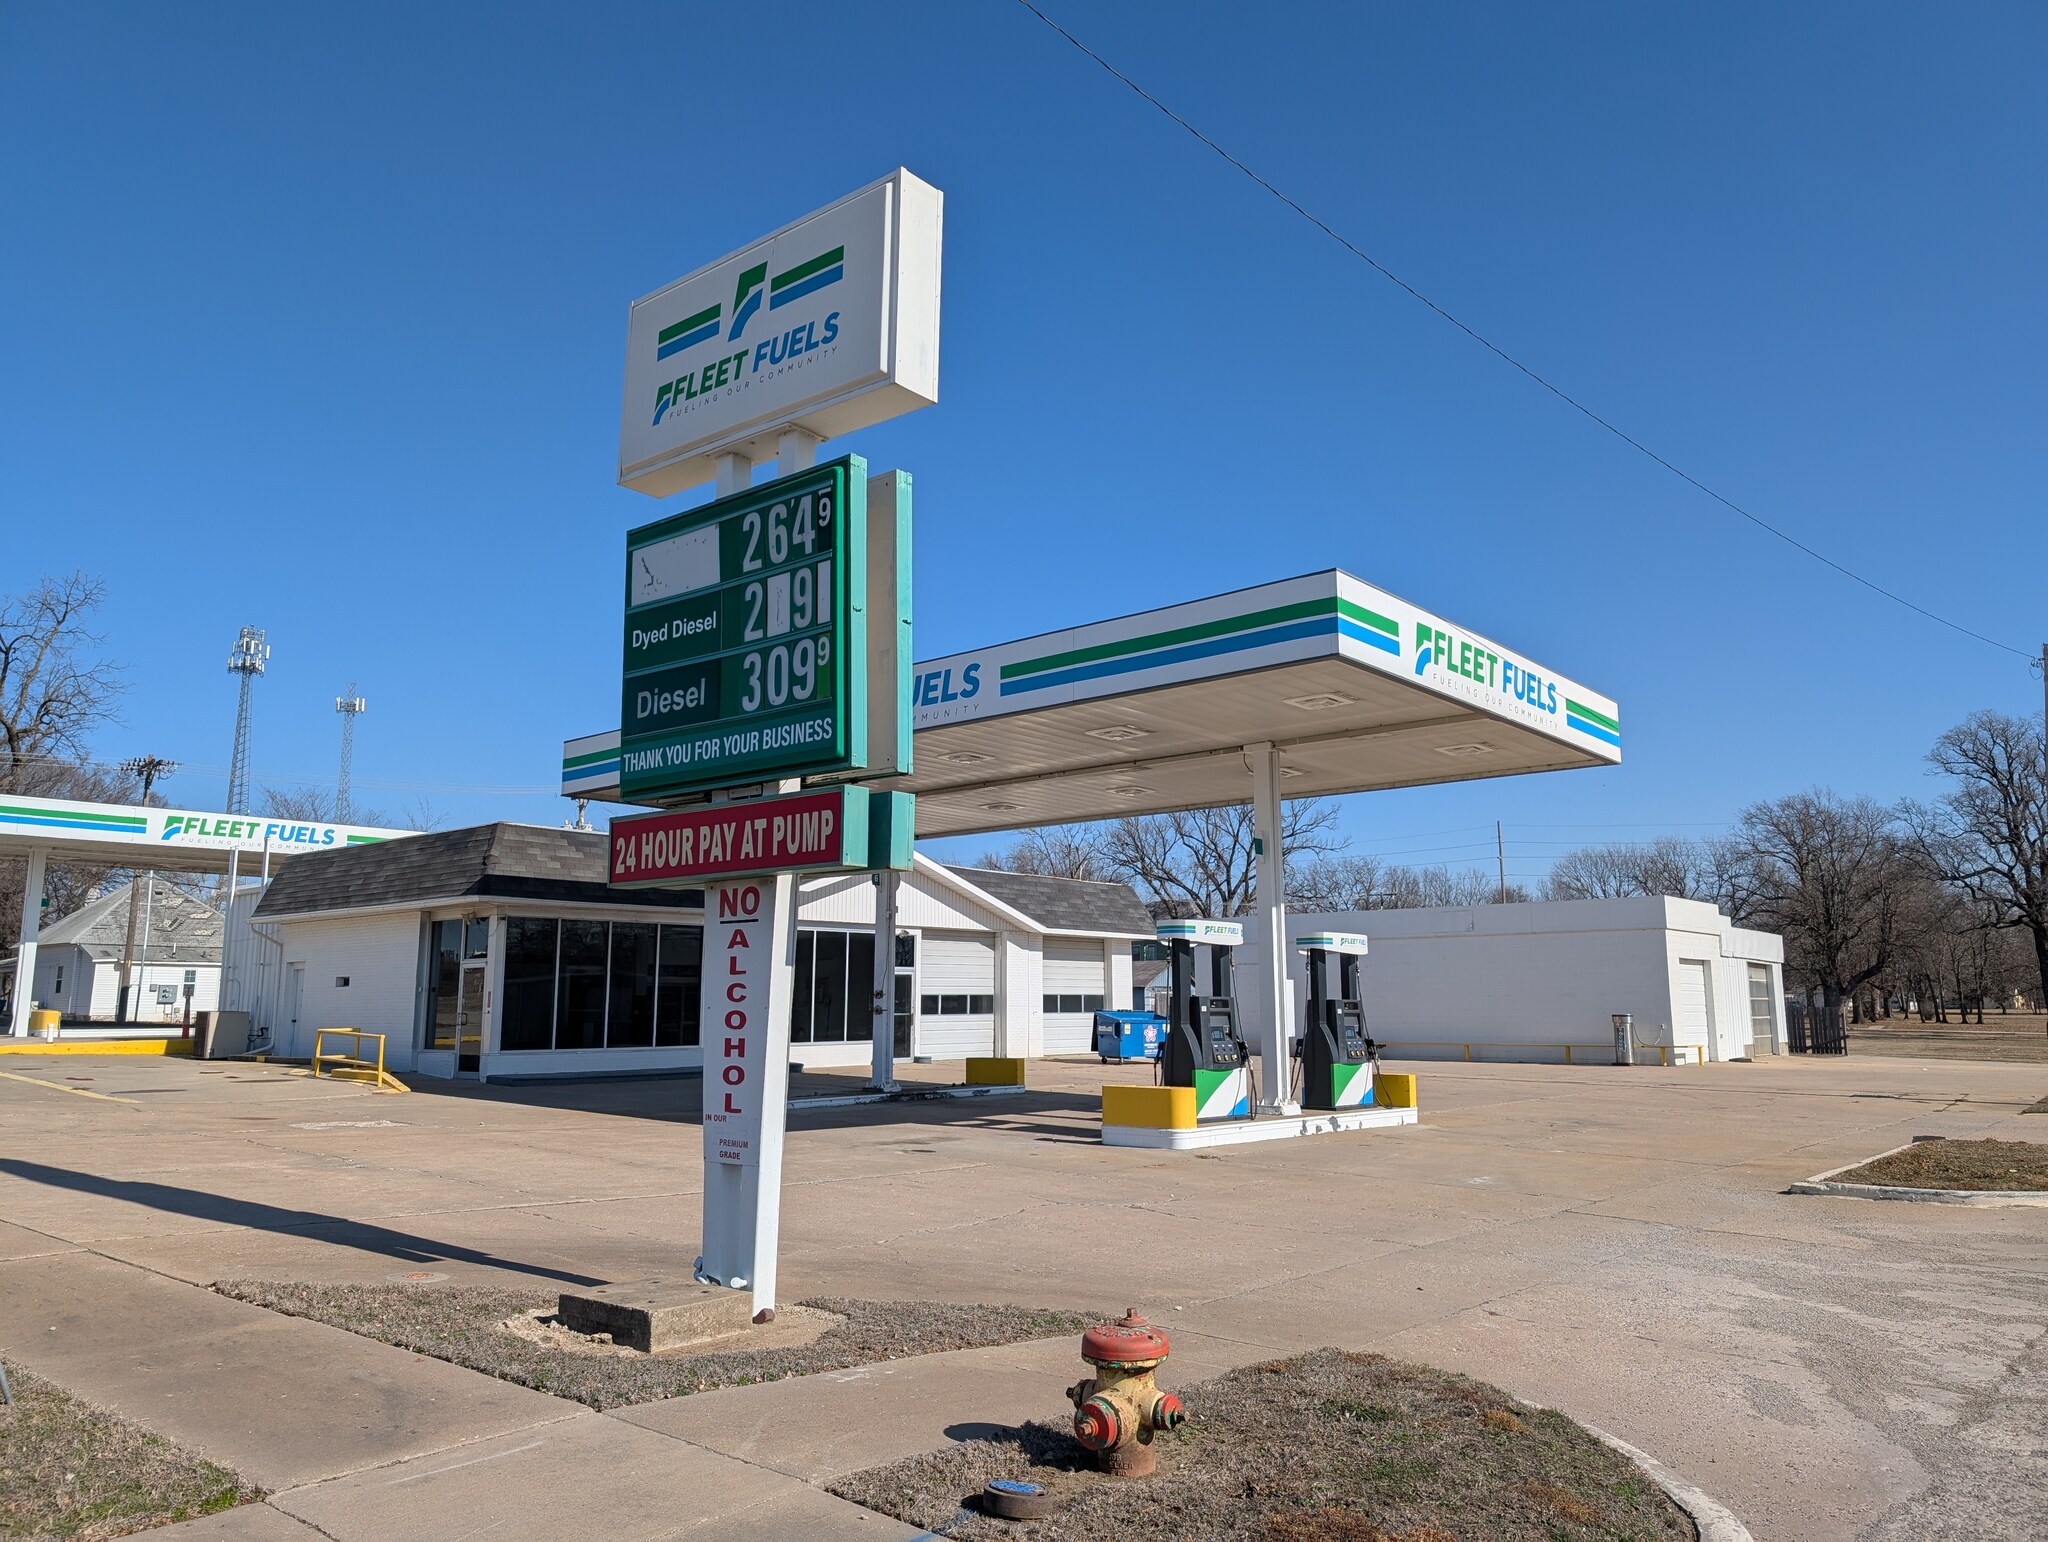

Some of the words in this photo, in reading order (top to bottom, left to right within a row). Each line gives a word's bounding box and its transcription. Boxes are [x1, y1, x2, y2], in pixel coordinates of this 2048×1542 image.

[671, 349, 749, 407] FLEET
[752, 311, 840, 373] FUELS
[669, 394, 719, 420] FUELING
[727, 381, 750, 397] OUR
[759, 346, 838, 383] COMMUNITY
[632, 624, 668, 650] Dyed
[672, 611, 717, 638] Diesel
[913, 663, 981, 707] ELS
[1434, 629, 1498, 688] FLEET
[1502, 659, 1556, 715] FUELS
[636, 677, 706, 719] Diesel
[913, 703, 980, 723] MUNITY
[1433, 672, 1478, 698] FUELING
[1485, 692, 1502, 706] OUR
[1508, 703, 1559, 731] COMMUNITY
[623, 747, 663, 773] THANK
[666, 742, 693, 765] YOU
[695, 740, 720, 761] FOR
[724, 732, 760, 757] YOUR
[763, 717, 832, 749] BUSINESS
[181, 837, 232, 846] FUELING
[270, 843, 320, 852] COMMUN
[183, 817, 260, 840] FLEET
[265, 823, 335, 846] FUELS
[615, 836, 636, 874] 24
[640, 828, 694, 870] HOUR
[699, 822, 736, 864] PAY
[740, 818, 767, 860] AT
[772, 809, 834, 856] PUMP
[719, 886, 760, 918] NO
[722, 928, 750, 1114] ALCOHOL
[713, 1114, 727, 1122] OUR
[719, 1138, 749, 1149] PREMIUM
[719, 1150, 741, 1160] GRADE
